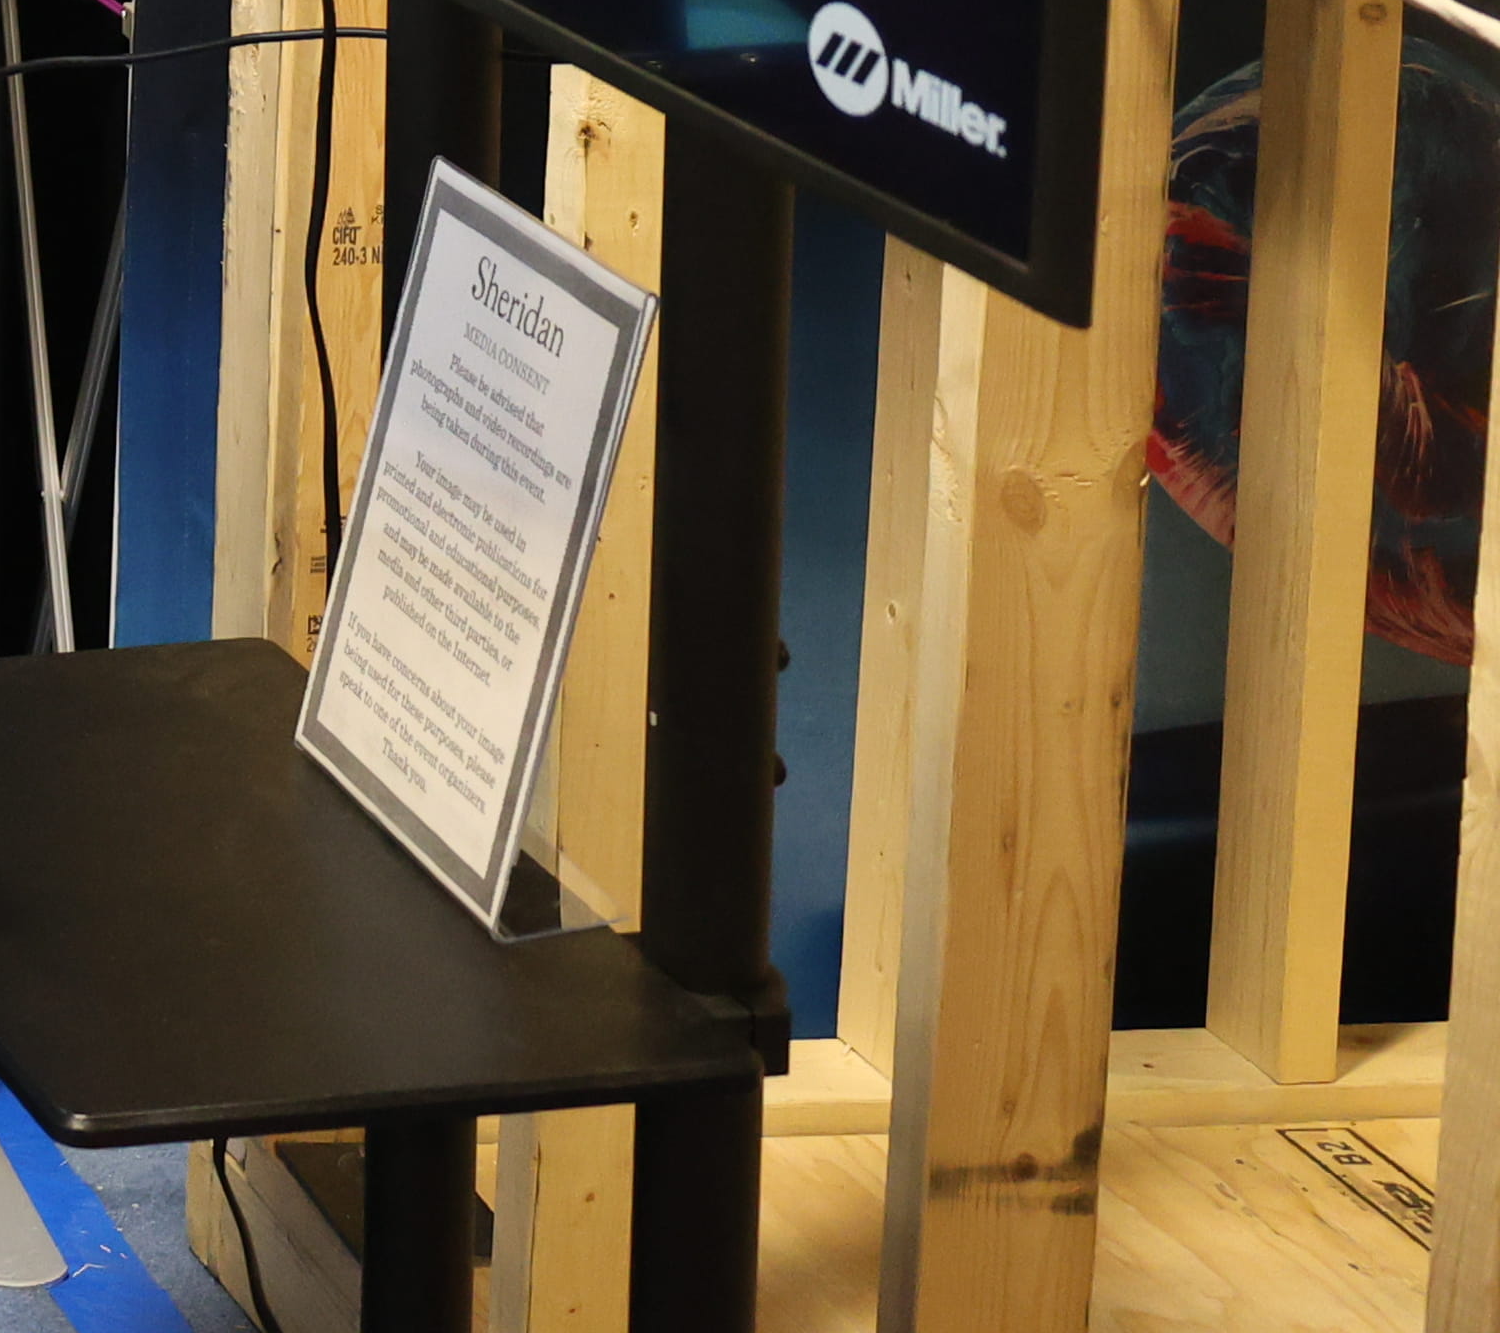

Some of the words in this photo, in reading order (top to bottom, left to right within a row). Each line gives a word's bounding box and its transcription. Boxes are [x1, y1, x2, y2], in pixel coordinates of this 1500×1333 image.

[332, 246, 367, 266] 240-3
[471, 256, 563, 356] Sheridan
[449, 353, 477, 387] Please
[477, 374, 489, 396] be
[489, 388, 526, 422] advised
[524, 411, 544, 437] that
[463, 321, 497, 359] MEDIA
[497, 347, 549, 394] CONSENT
[410, 359, 463, 407] photographs
[463, 400, 483, 422] and
[481, 413, 507, 440] video
[506, 432, 554, 477] recordings
[555, 470, 571, 490] are
[420, 393, 446, 428] being
[445, 415, 470, 445] taken
[469, 433, 501, 470] during
[500, 456, 518, 482] this
[518, 474, 544, 504] event.
[376, 485, 429, 536] promotional
[428, 529, 446, 550] and
[445, 543, 497, 593] educational
[495, 584, 539, 630] purposes,
[382, 461, 416, 494] printed
[414, 486, 434, 508] and
[432, 498, 475, 543] electronic
[474, 536, 531, 589] publications
[531, 578, 547, 601] for
[415, 450, 436, 479] Your
[435, 467, 462, 500] image
[461, 493, 482, 518] may
[481, 503, 493, 525] be
[493, 518, 516, 544] used
[514, 532, 526, 553] in
[377, 548, 403, 578] media
[403, 571, 422, 593] and
[420, 585, 444, 612] other
[444, 603, 467, 633] third
[465, 625, 499, 663] parties,
[500, 654, 513, 671] or
[382, 522, 400, 543] and
[398, 536, 418, 561] may
[417, 546, 429, 569] be
[428, 561, 453, 589] made
[453, 582, 492, 622] available
[492, 612, 503, 632] to
[504, 621, 520, 645] the
[382, 585, 426, 628] published
[424, 621, 436, 639] on
[437, 629, 452, 652] the
[452, 640, 490, 686] Internet.
[339, 670, 363, 700] speak
[363, 690, 372, 708] to
[372, 701, 388, 723] one
[388, 716, 401, 733] of
[398, 723, 413, 746] the
[413, 740, 438, 769] event
[438, 763, 485, 813] organizers.
[343, 638, 368, 674] being
[367, 664, 388, 690] used
[386, 679, 401, 701] for
[400, 693, 424, 723] these
[423, 717, 464, 763] purposes,
[465, 754, 495, 789] please
[347, 610, 357, 630] If
[354, 622, 371, 644] you
[371, 632, 391, 661] have
[391, 656, 430, 697] concerns
[430, 689, 456, 720] about
[454, 712, 477, 739] your
[477, 728, 505, 764] image
[382, 736, 409, 775] Thank
[407, 766, 426, 793] you.
